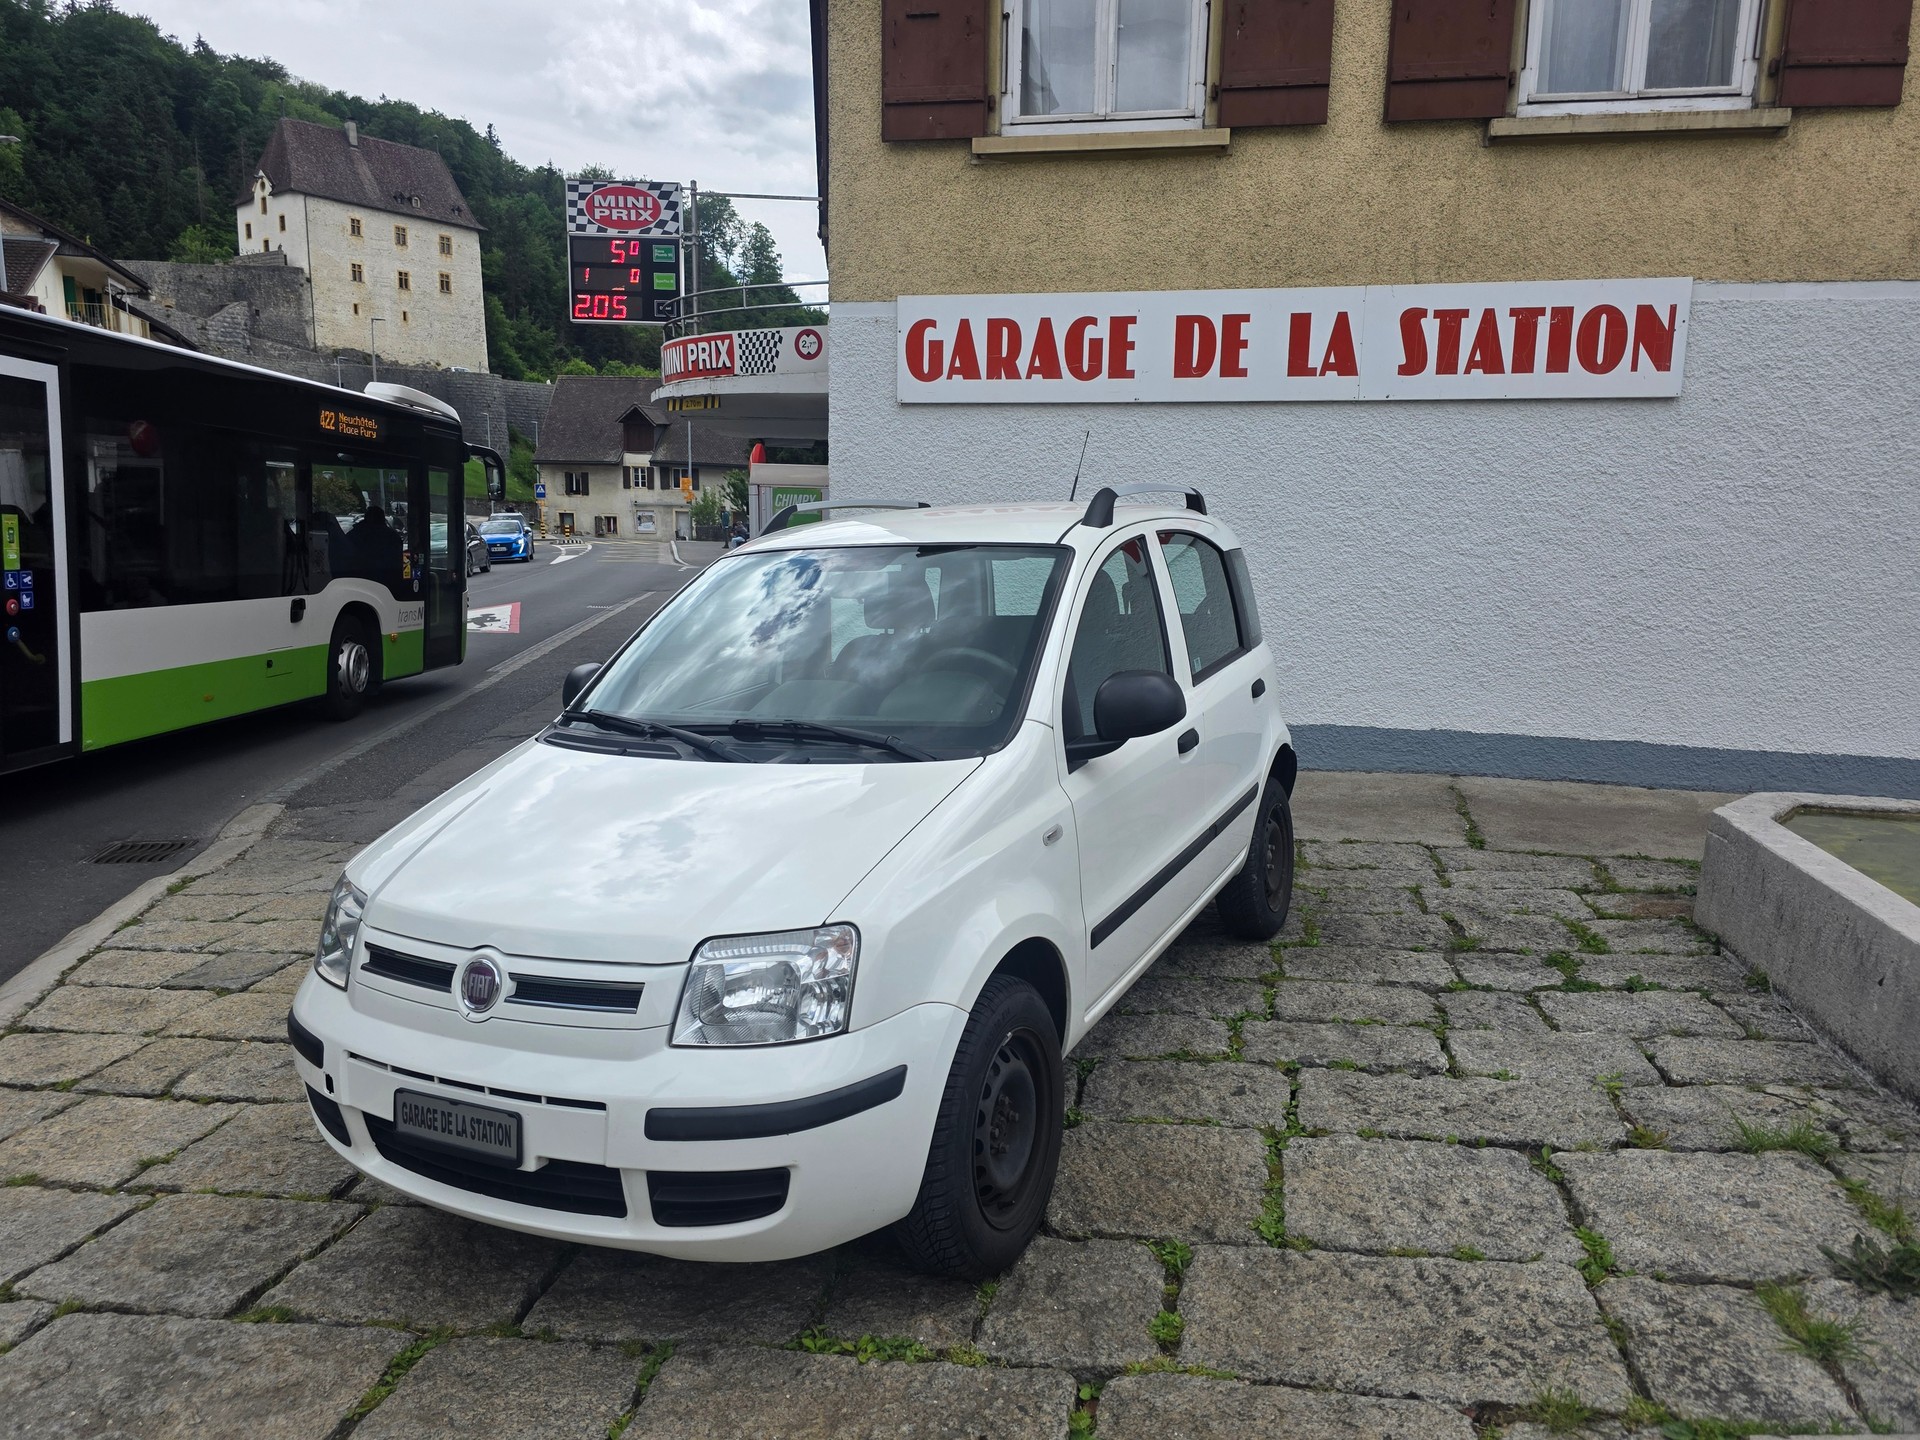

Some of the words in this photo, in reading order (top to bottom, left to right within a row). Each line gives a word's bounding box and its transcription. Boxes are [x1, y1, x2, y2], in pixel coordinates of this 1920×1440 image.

[594, 195, 653, 209] MINI
[594, 208, 655, 222] PRIX
[574, 294, 628, 319] 2.05
[905, 315, 1138, 382] GARAGE
[1173, 313, 1251, 379] DE
[1287, 311, 1359, 378] LA
[1397, 303, 1678, 377] STATION
[663, 345, 684, 376] MINI
[687, 338, 732, 372] PRIX
[320, 410, 336, 430] 422
[339, 422, 359, 436] Place
[468, 973, 492, 999] FIAT
[401, 1101, 438, 1132] GARAGE
[440, 1110, 453, 1135] DE
[455, 1113, 468, 1138] LA
[470, 1116, 512, 1148] STATION
